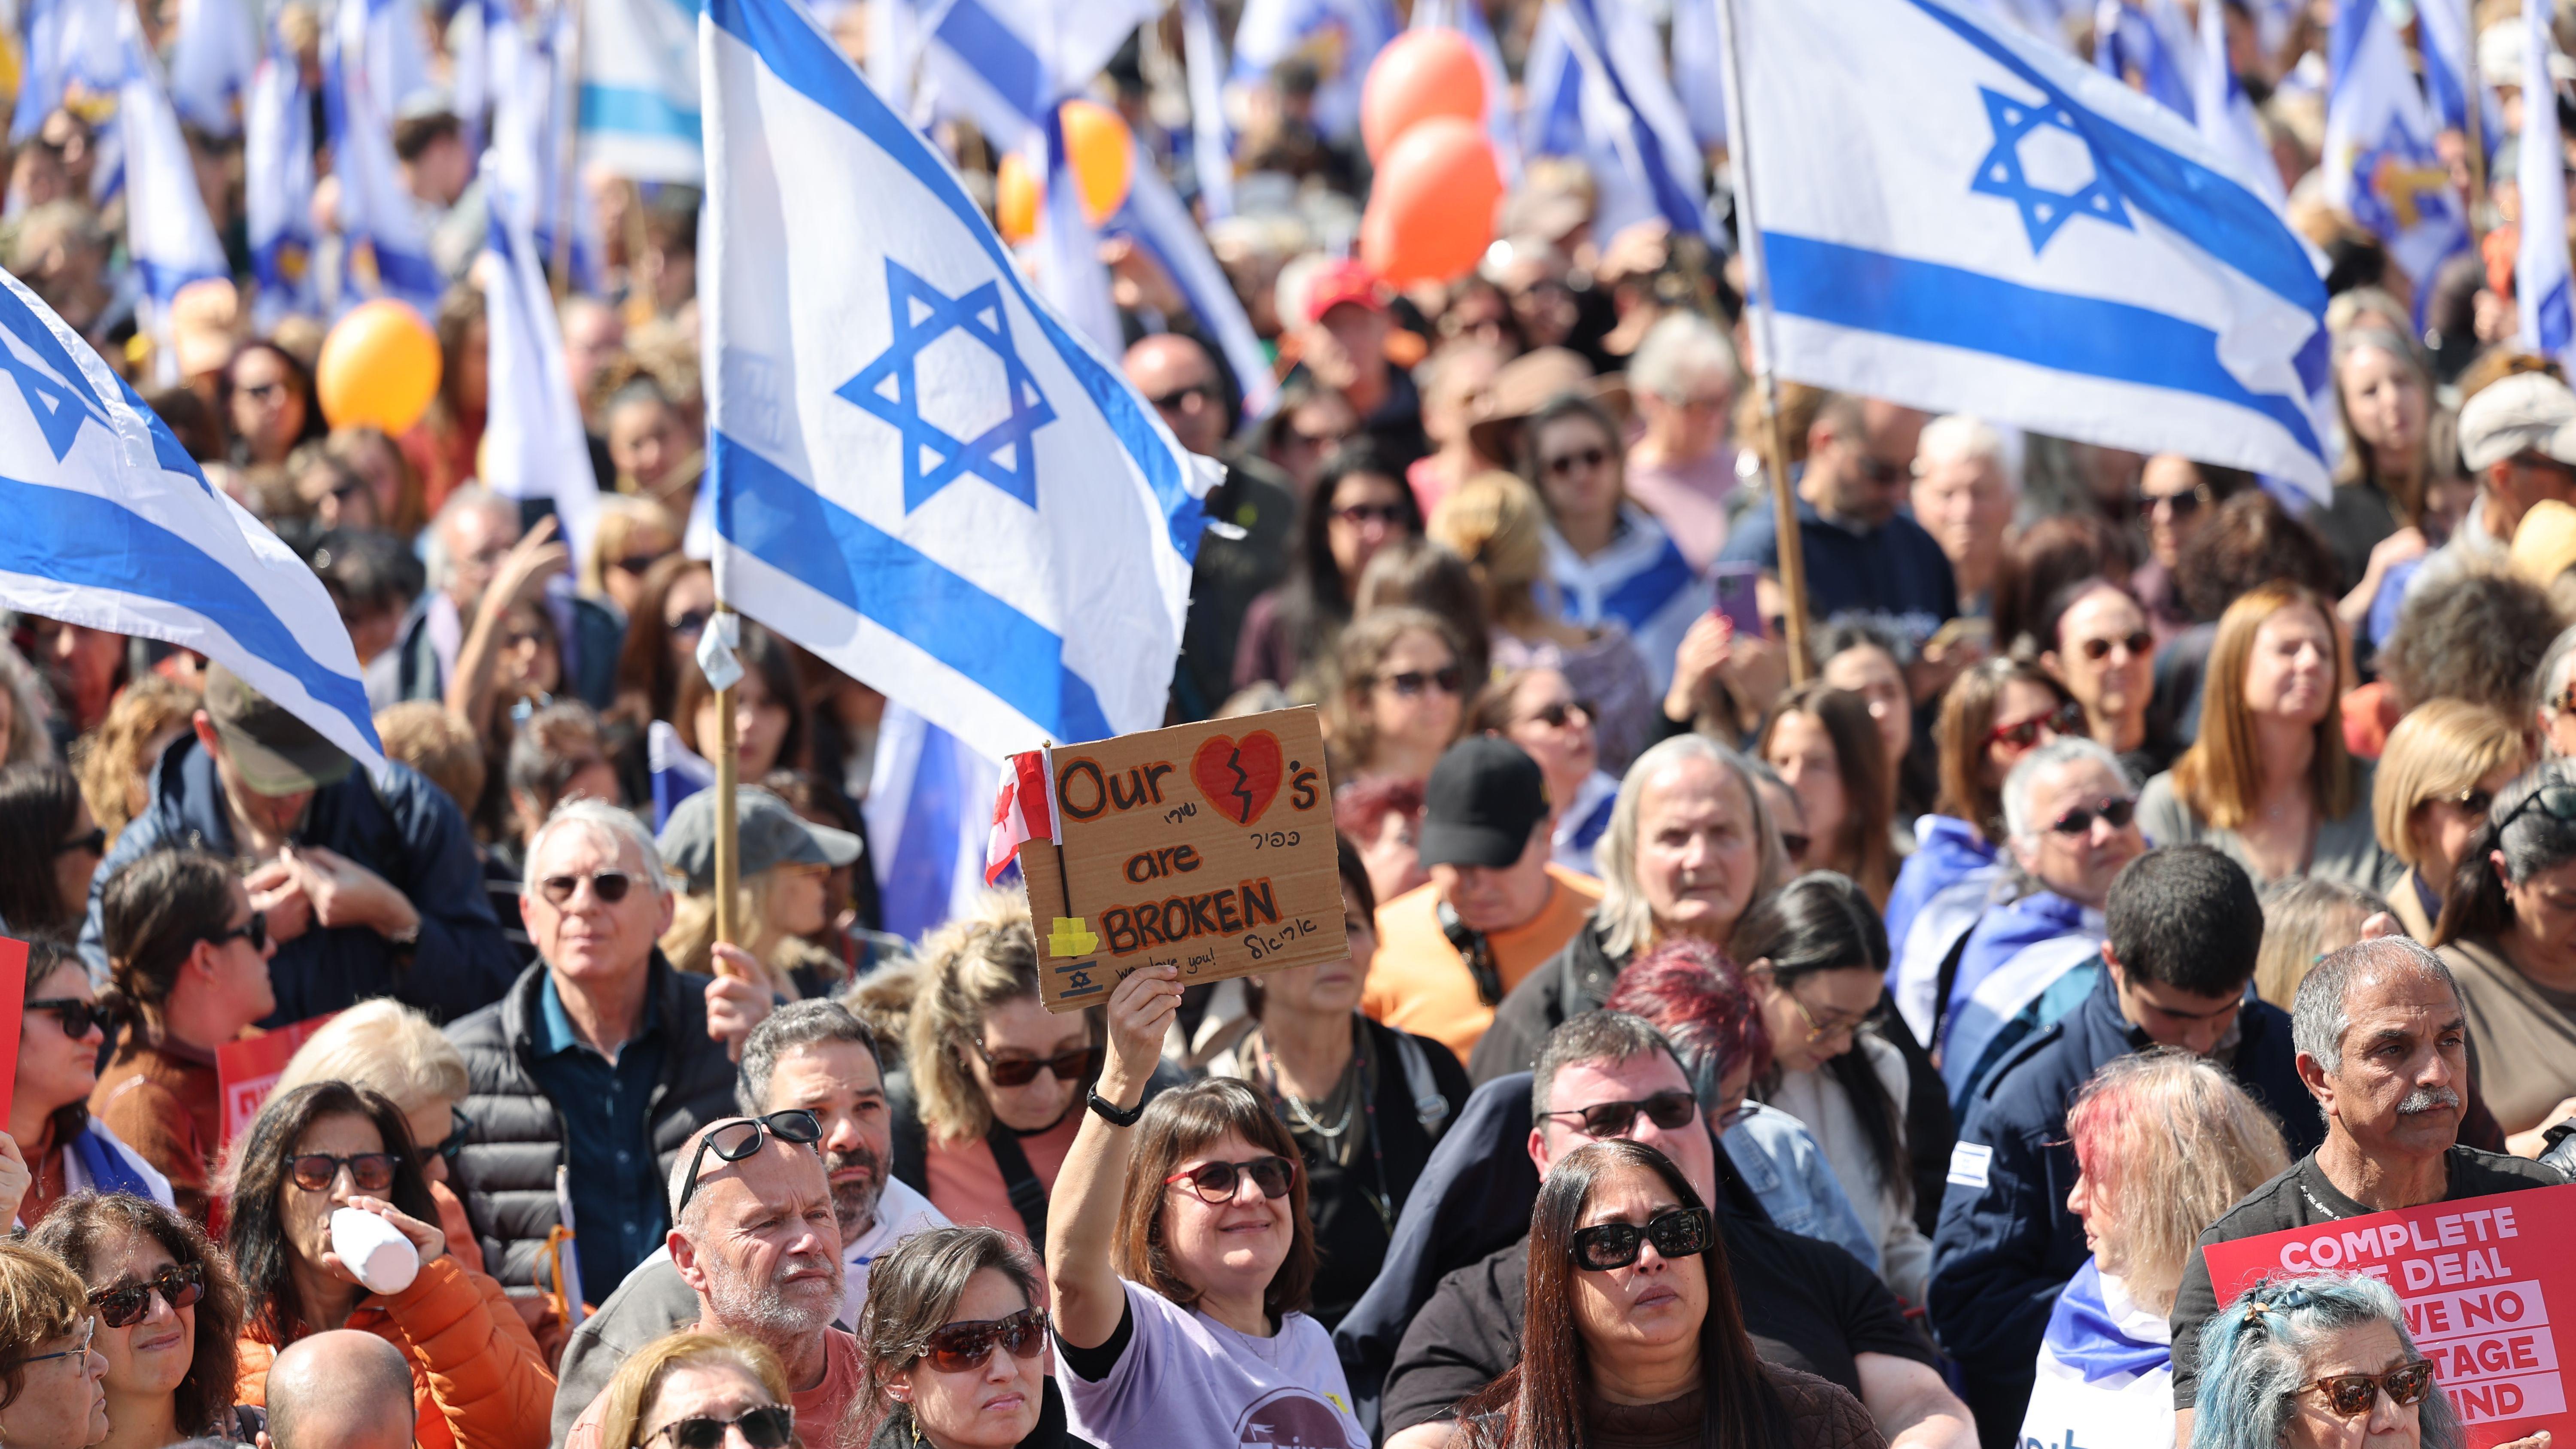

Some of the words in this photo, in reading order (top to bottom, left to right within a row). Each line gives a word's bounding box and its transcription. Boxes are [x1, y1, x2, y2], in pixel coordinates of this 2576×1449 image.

[1057, 759, 1174, 820] Our
[1289, 760, 1318, 811] 's
[1126, 845, 1201, 883] are
[1102, 881, 1279, 955] BROKEN
[1186, 947, 1216, 975] you!
[2279, 1206, 2518, 1272] COMPLETE
[2401, 1247, 2512, 1291] DEAL
[2458, 1290, 2524, 1328] NO
[2420, 1335, 2539, 1380] TAGE
[2448, 1383, 2524, 1422] IND
